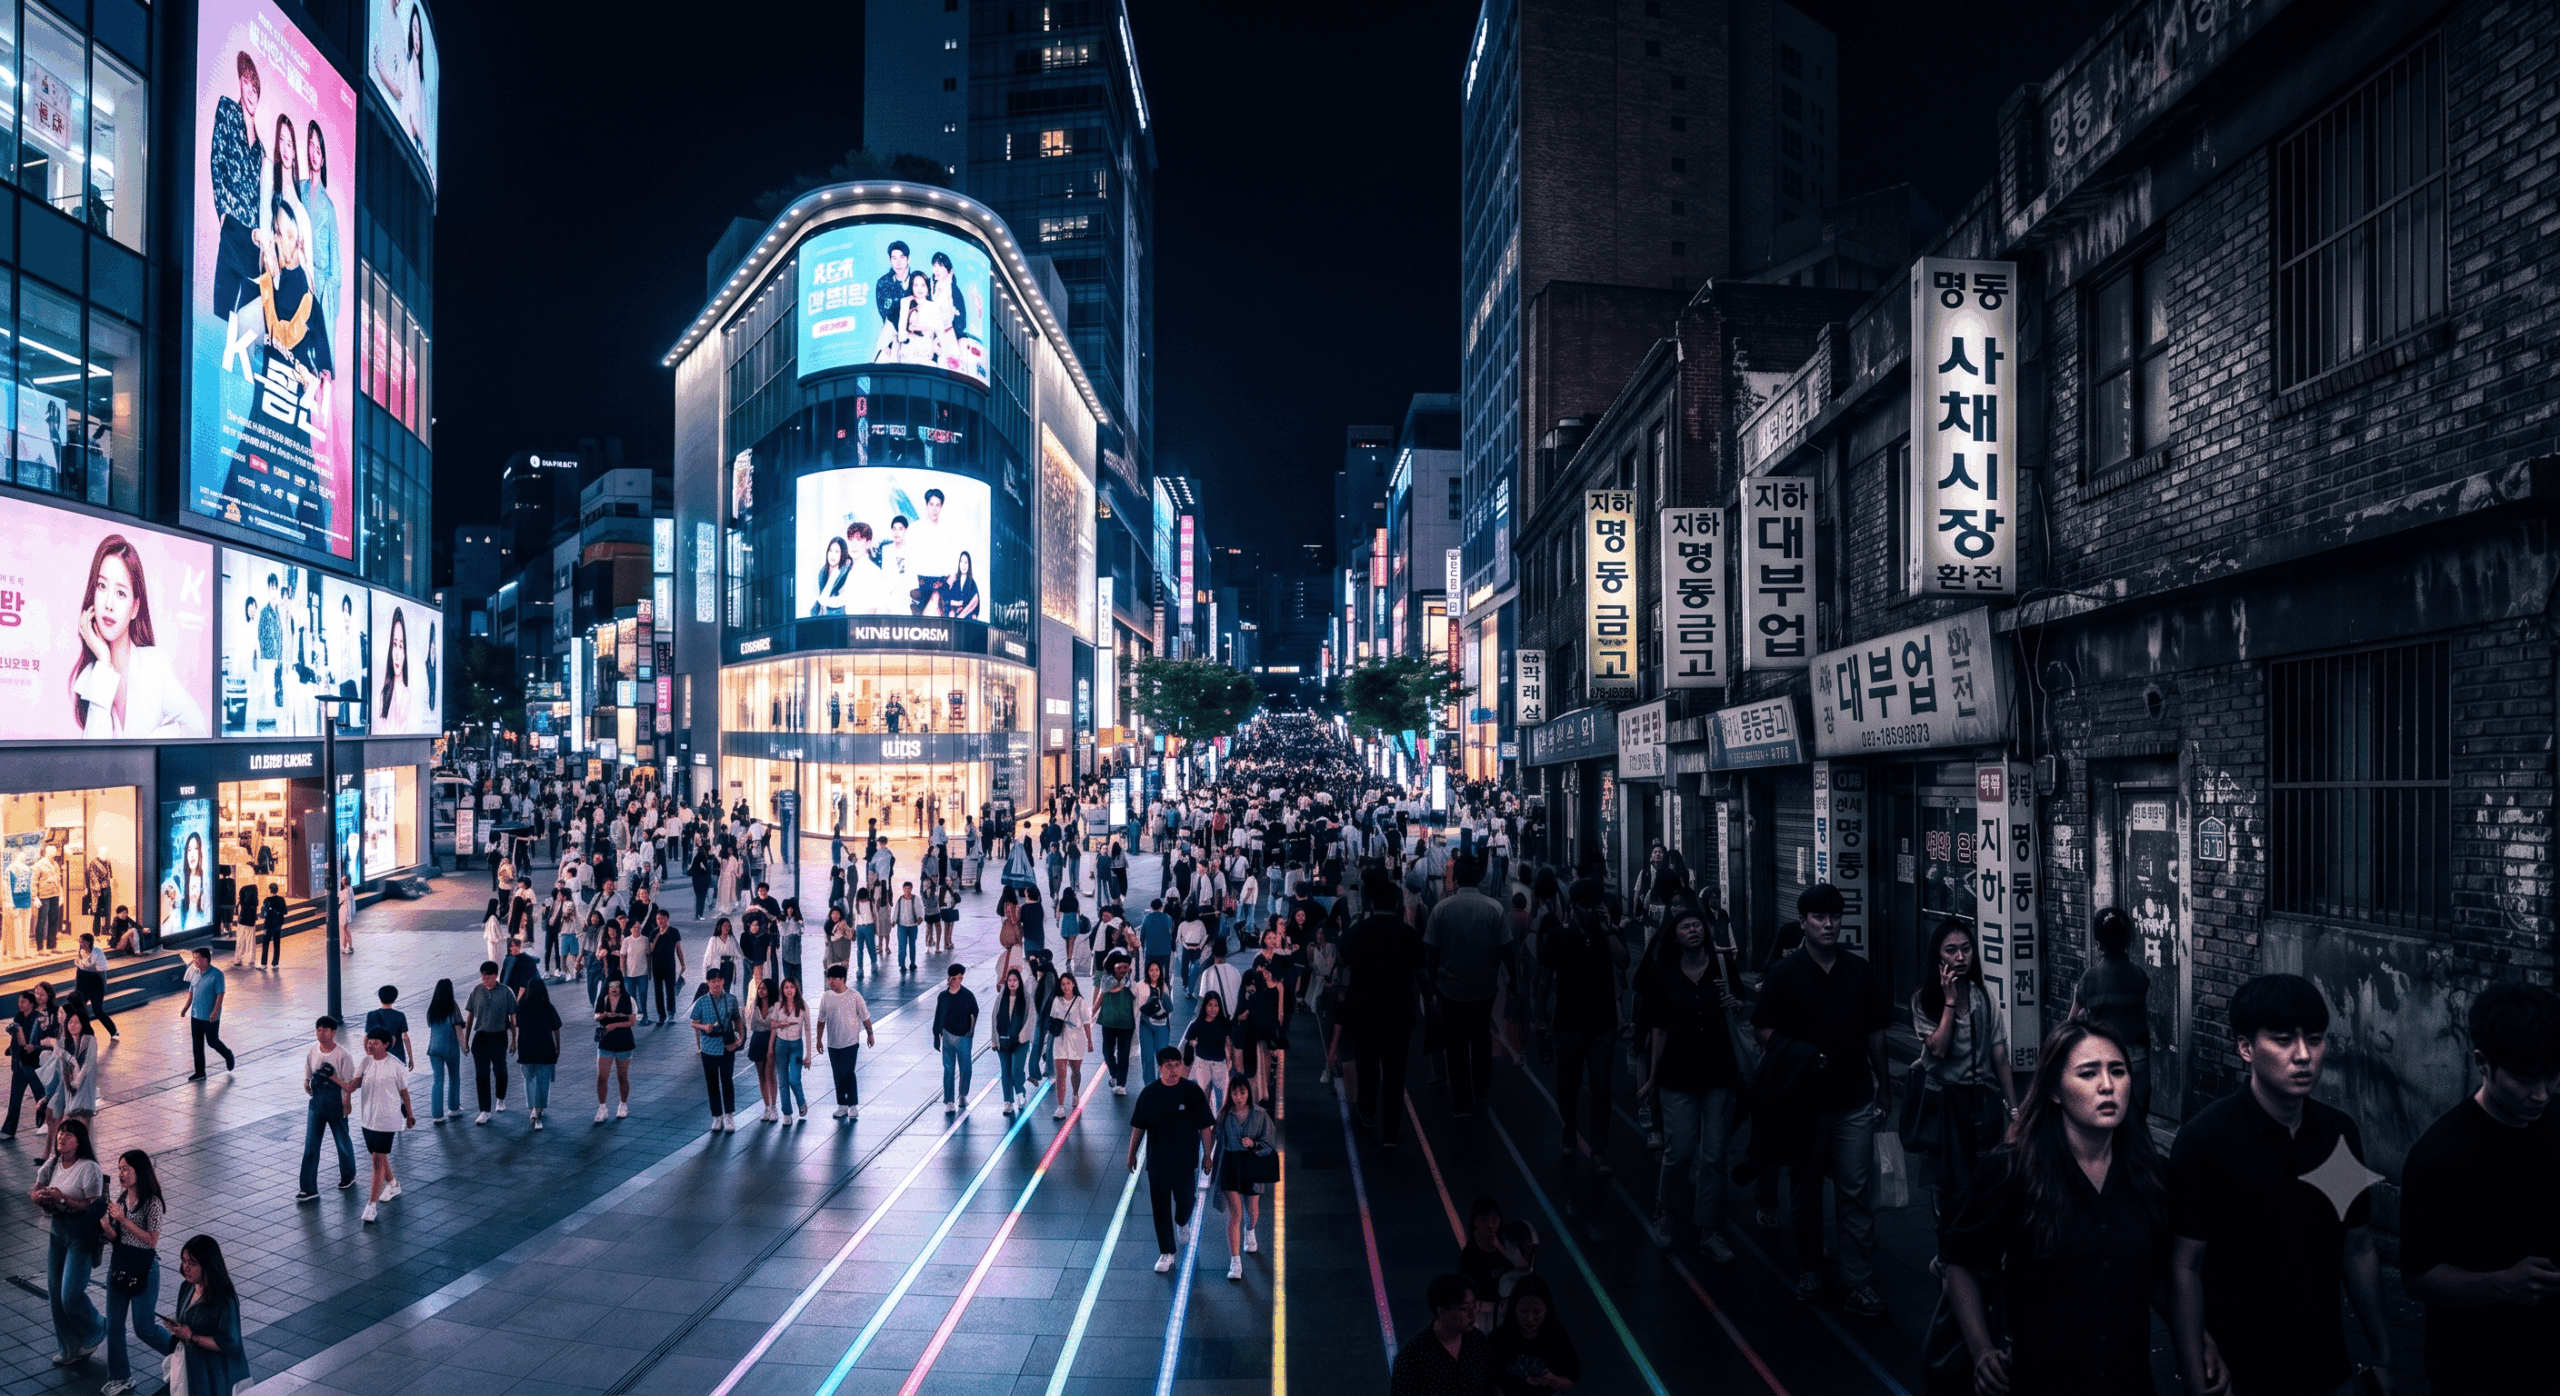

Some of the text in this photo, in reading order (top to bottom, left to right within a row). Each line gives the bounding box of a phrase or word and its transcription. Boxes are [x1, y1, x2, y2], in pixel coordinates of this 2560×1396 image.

[1933, 271, 2009, 311] 명동
[1937, 336, 2005, 561] 사채시장
[1590, 492, 1633, 514] 지하
[1672, 511, 1721, 537] 지하
[1754, 482, 1809, 512] 지하
[1595, 519, 1630, 680] 명동금고
[1676, 541, 1717, 678] 명동금고
[1757, 516, 1806, 658] 대부업
[1936, 564, 2005, 592] 환전
[1836, 633, 1938, 723] 대부업
